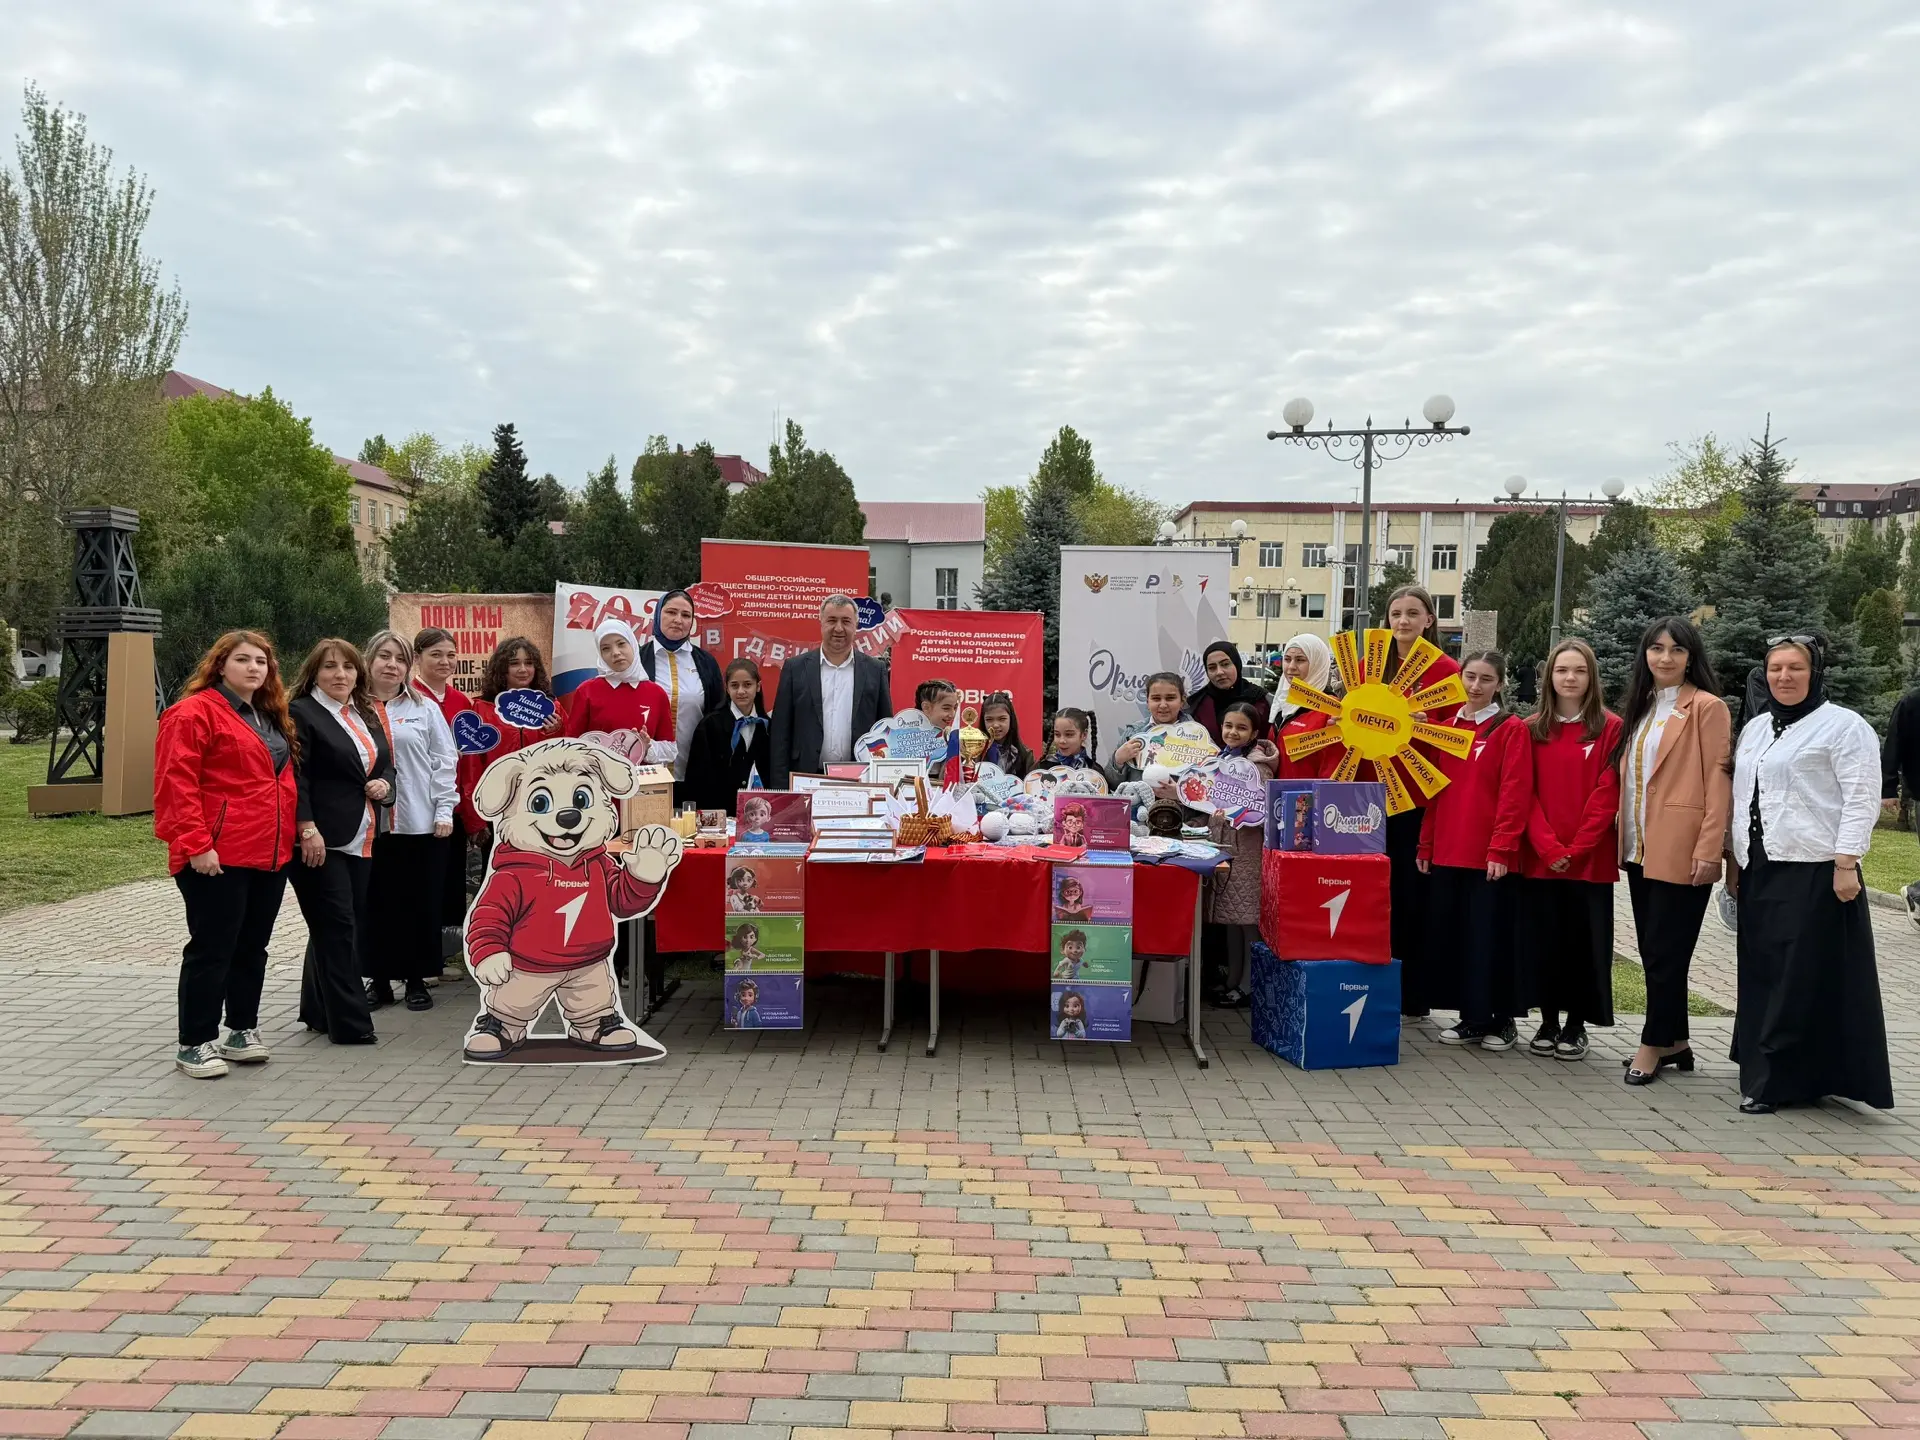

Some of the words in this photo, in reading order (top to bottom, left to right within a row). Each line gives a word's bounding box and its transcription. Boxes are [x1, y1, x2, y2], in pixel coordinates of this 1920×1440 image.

[745, 574, 826, 584] ОБЩЕРОССИЙСКОЕ
[718, 583, 859, 595] БЩЕСТВЕННО-ГОСУДАРСТВЕННОЕ
[730, 592, 765, 600] ИЖЕНИЕ
[767, 593, 793, 601] ДЕТЕЙ
[736, 610, 791, 619] РЕСПУБЛИКИ
[741, 602, 790, 610] «ДВИЖЕНИЕ
[792, 603, 822, 611] ПЕРВЫ
[421, 605, 466, 629] ПОКА
[472, 605, 503, 629] МЫ
[706, 629, 721, 645] В
[910, 629, 972, 639] Российское
[974, 631, 1026, 640] движение
[920, 637, 951, 646] детей
[961, 640, 1015, 648] молодежи
[916, 646, 973, 655] «Движение
[975, 647, 1020, 656] Первых»
[1367, 642, 1375, 676] НАРОДОВ
[912, 654, 973, 664] Республики
[975, 656, 1023, 665] Дагестан
[1393, 650, 1422, 685] СЛУЖЕНИЕ
[1400, 654, 1430, 691] ОТЕЧЕСТВУ
[1290, 684, 1341, 709] СОЗИДАТЕЛЬНЫЙ
[1415, 685, 1449, 702] КРЕПКАЯ
[1422, 695, 1447, 708] СЕМЬЯ
[519, 694, 543, 710] Наша
[1306, 699, 1321, 709] ТРУД
[506, 701, 545, 720] дружная
[509, 710, 539, 726] семья!
[1357, 713, 1395, 731] МЕЧТА
[1299, 733, 1320, 743] ДОБРО
[1412, 725, 1465, 746] ПАТРИОТИЗМ
[1288, 736, 1341, 754] СПРАВЕДЛИВОСТЬ
[1344, 763, 1357, 782] МЯТЬ
[1400, 749, 1434, 786] ДРУЖБА
[1386, 767, 1401, 793] ЖИЗНЬ
[813, 799, 863, 808] СЕРТИФИКАТ
[1207, 788, 1267, 814] ДОБРОВОЛЕЦ
[554, 879, 590, 889] Первые
[1318, 877, 1352, 886] Первые
[1339, 982, 1369, 991] Первые
